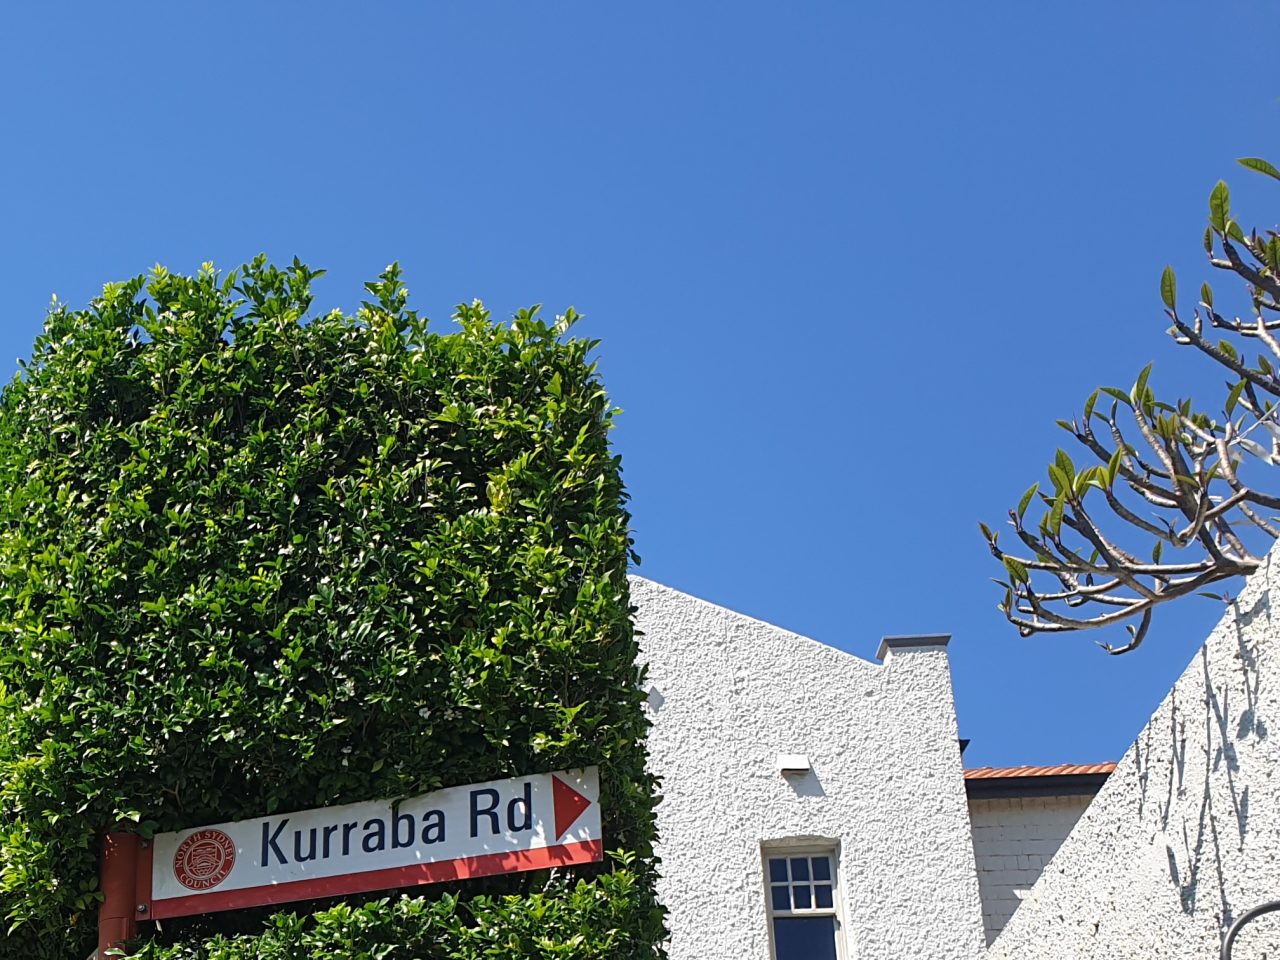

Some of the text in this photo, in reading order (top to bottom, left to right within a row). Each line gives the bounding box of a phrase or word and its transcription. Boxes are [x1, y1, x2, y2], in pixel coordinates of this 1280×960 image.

[261, 782, 532, 868] Kurraba Rd
[175, 830, 234, 868] NORTH SYDNEY
[180, 869, 228, 889] COUNCIL
